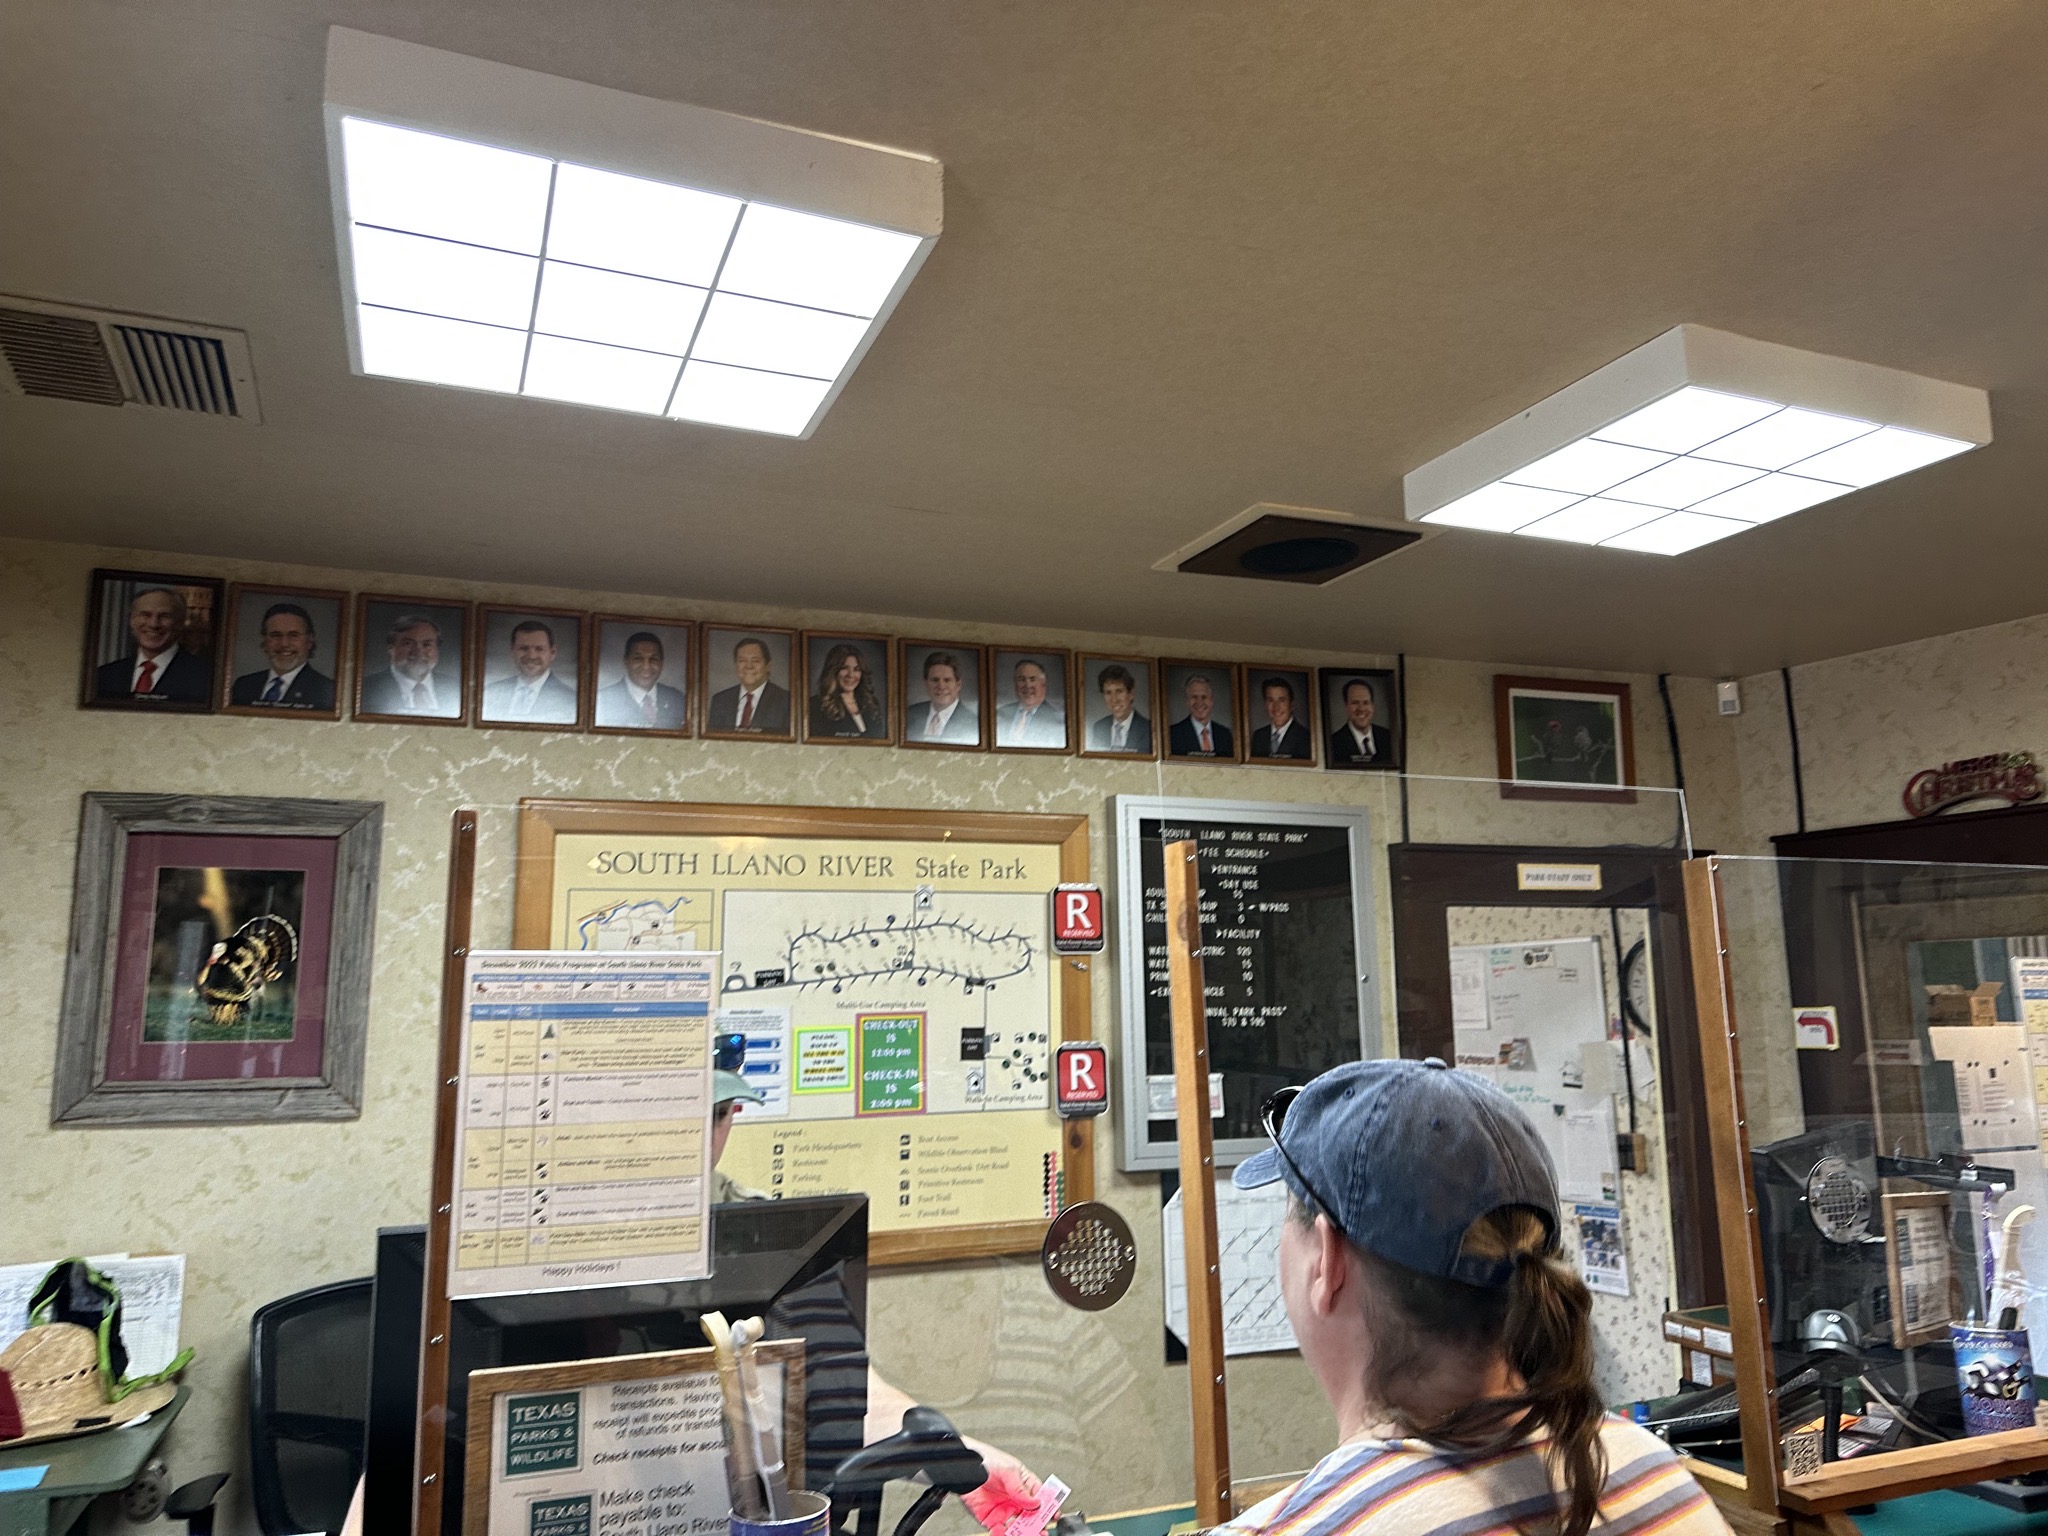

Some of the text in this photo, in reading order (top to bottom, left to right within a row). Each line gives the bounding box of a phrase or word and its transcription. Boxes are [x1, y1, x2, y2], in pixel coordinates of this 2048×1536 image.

[1200, 830, 1226, 841] LLANO
[1231, 831, 1254, 842] RIVER
[1257, 832, 1281, 843] STATE
[596, 850, 1028, 880] SOUTH LLANO RIVER State Park
[1242, 880, 1260, 891] USE
[1066, 893, 1092, 929] R
[1063, 929, 1095, 937] RESERVED
[874, 1001, 908, 1009] Camping
[1232, 1006, 1256, 1018] PARK
[864, 1019, 918, 1031] CHECK-OUT
[864, 1069, 919, 1081] CHECK-IN
[1069, 1053, 1096, 1091] R
[1066, 1090, 1099, 1099] RESERVED
[543, 1265, 574, 1277] Happy
[612, 1374, 720, 1398] Receipts available fo
[511, 1402, 577, 1423] TEXAS
[632, 1412, 650, 1424] will
[511, 1426, 575, 1445] PARKS &
[510, 1446, 576, 1467] WILDLIFE
[593, 1449, 630, 1465] Check
[631, 1444, 678, 1459] receipts
[680, 1441, 698, 1454] for
[600, 1481, 695, 1509] Make check
[534, 1502, 589, 1522] TEXAS
[599, 1502, 687, 1529] payable to:
[691, 1517, 731, 1534] River
